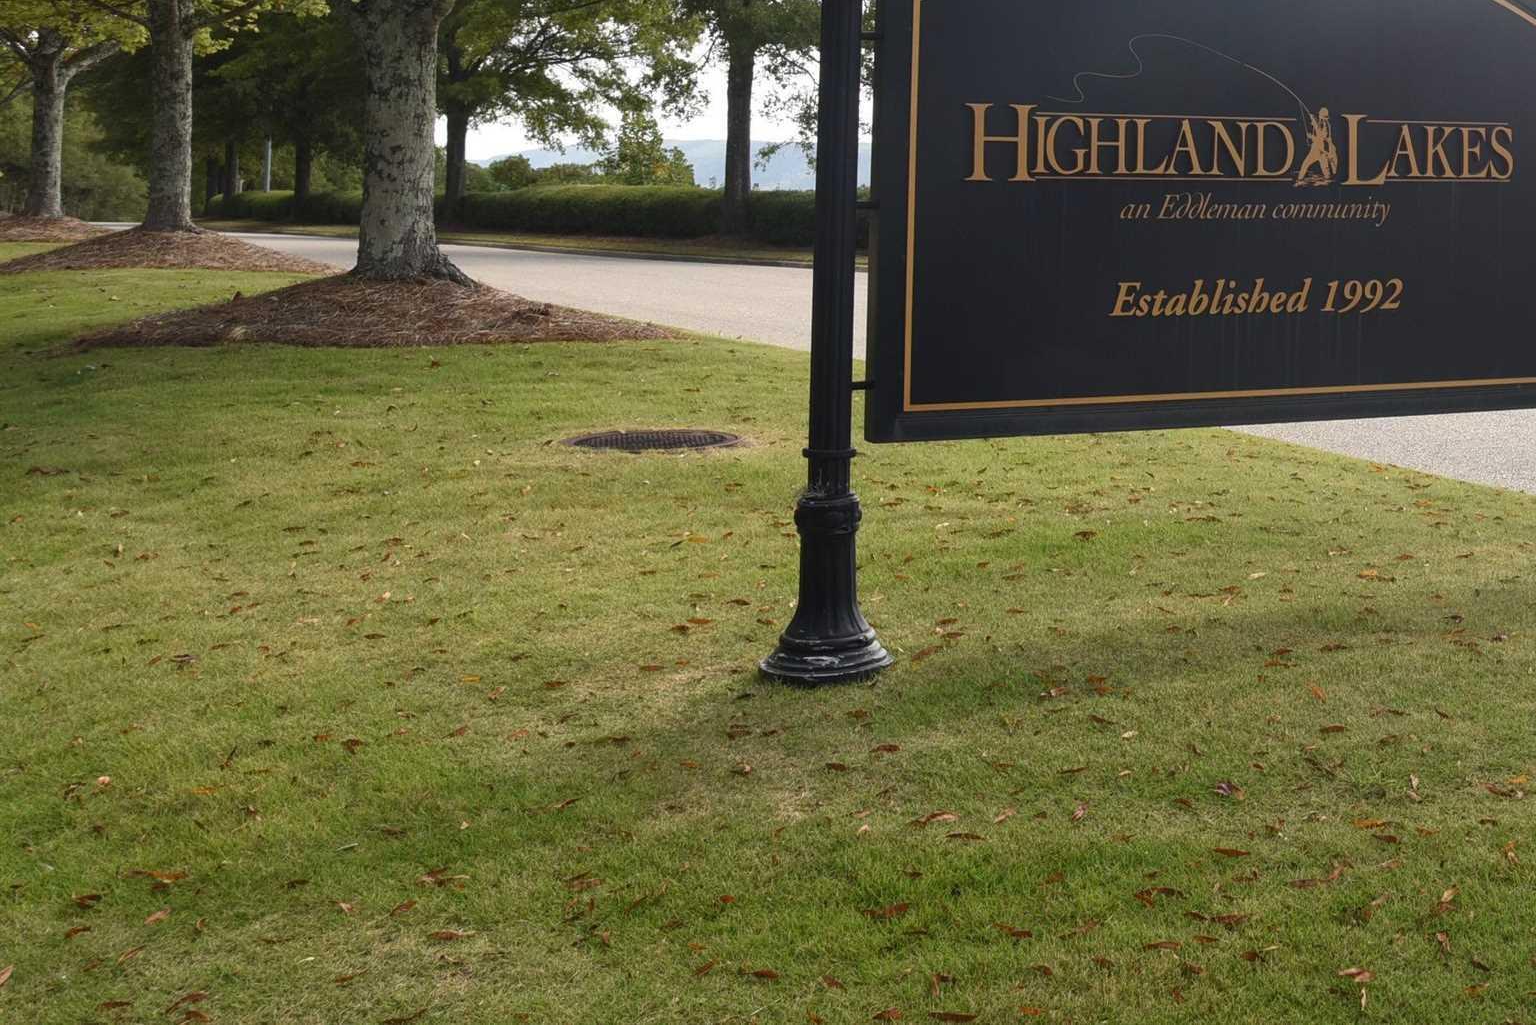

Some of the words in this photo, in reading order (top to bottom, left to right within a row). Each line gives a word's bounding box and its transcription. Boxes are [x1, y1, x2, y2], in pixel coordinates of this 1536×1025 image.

[965, 103, 1296, 182] HIGHLAND
[1341, 114, 1514, 185] LAKES
[1120, 201, 1151, 220] an
[1158, 193, 1266, 220] Eddleman
[1272, 198, 1391, 227] community
[1108, 277, 1313, 317] Established
[1321, 278, 1404, 314] 1992
